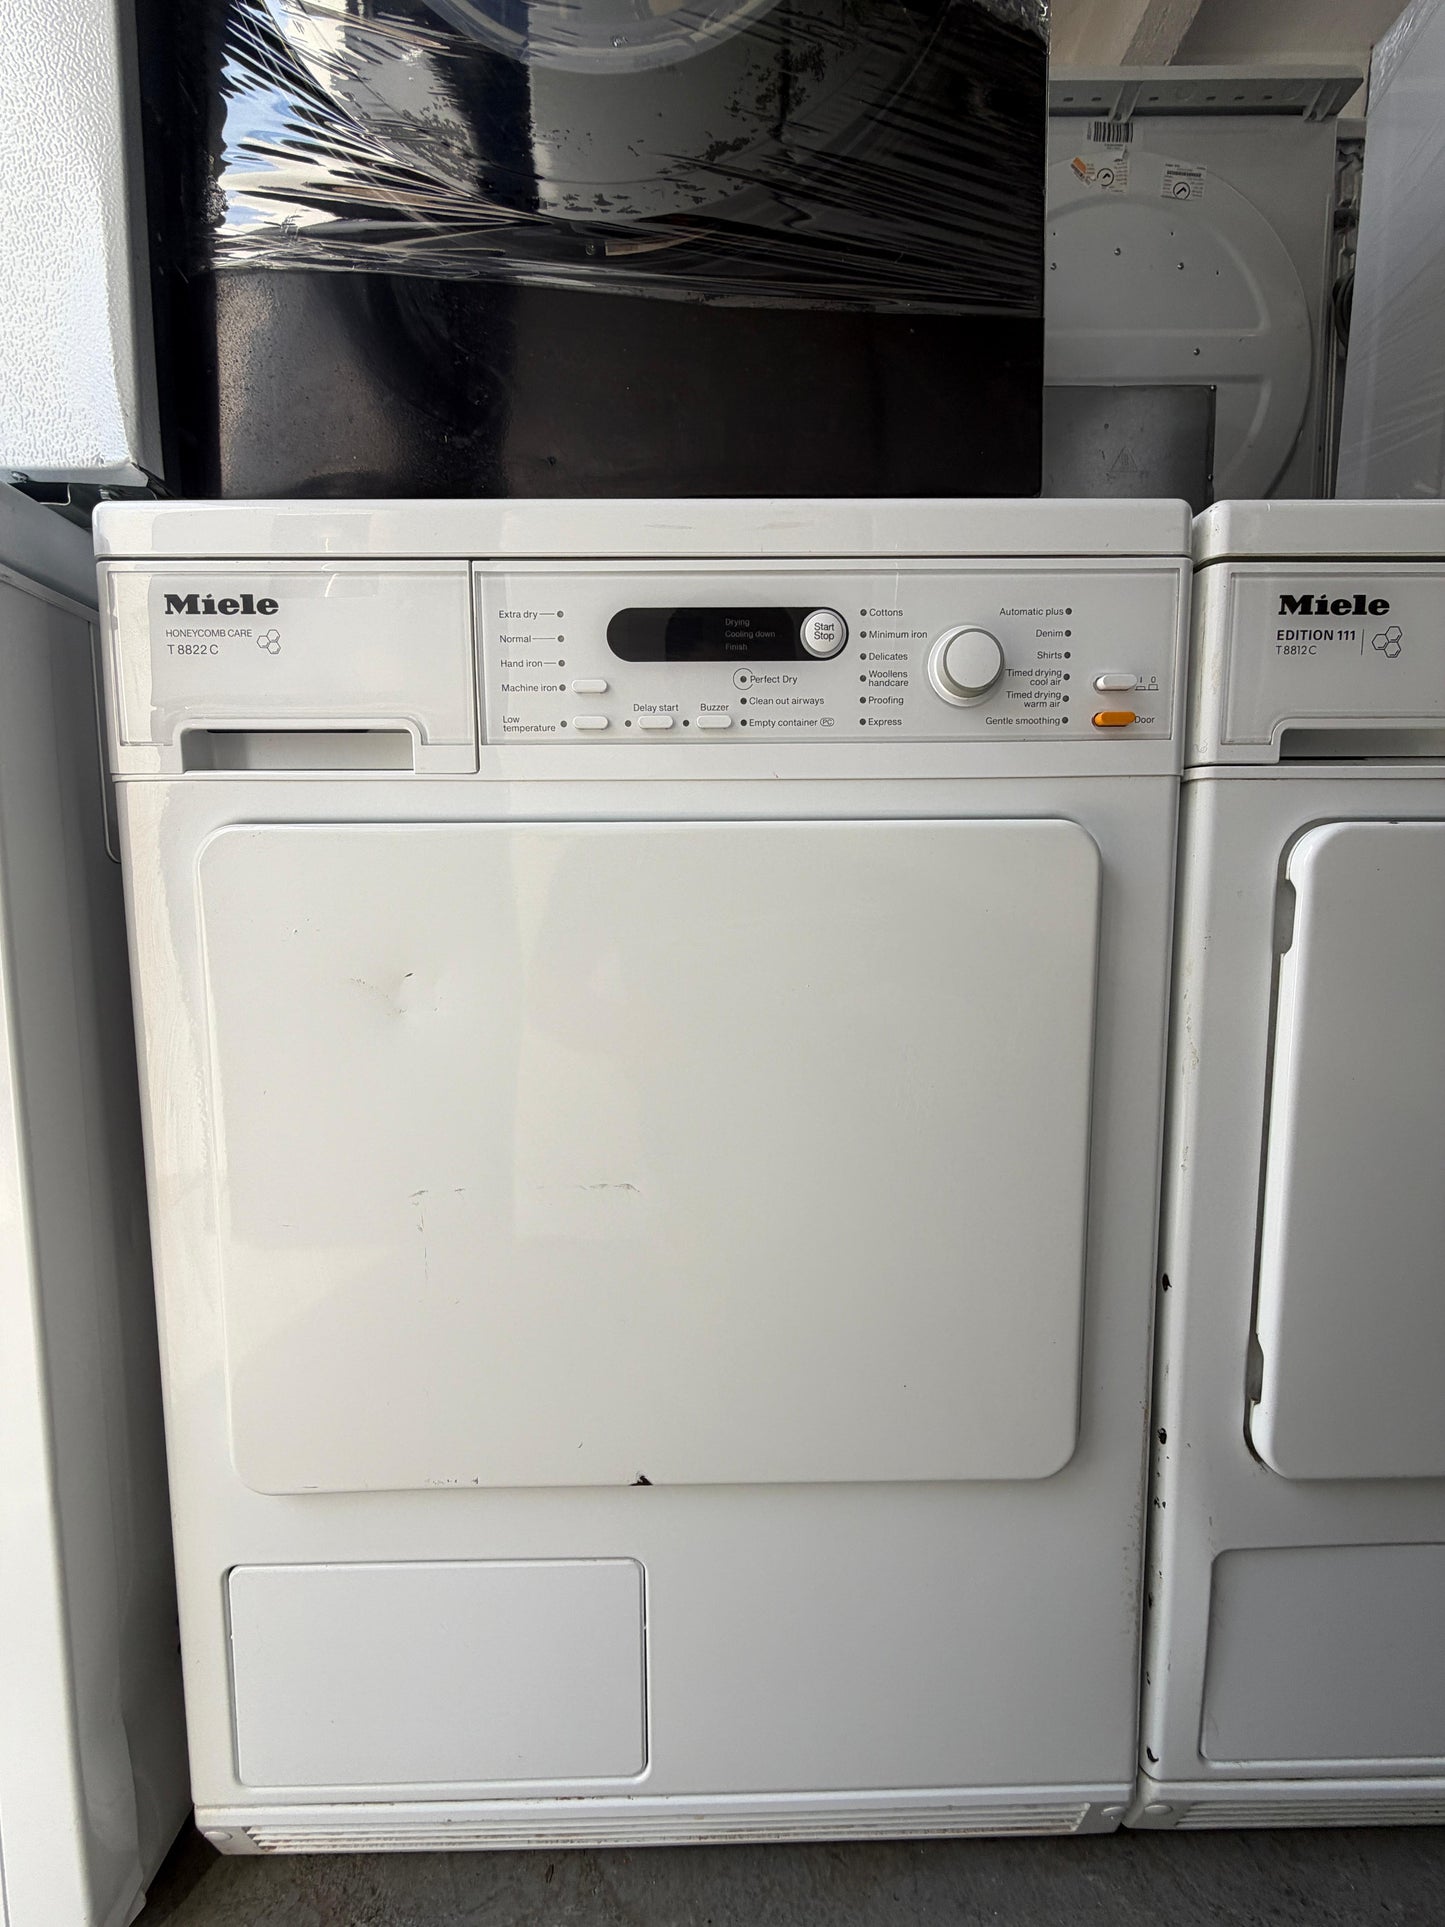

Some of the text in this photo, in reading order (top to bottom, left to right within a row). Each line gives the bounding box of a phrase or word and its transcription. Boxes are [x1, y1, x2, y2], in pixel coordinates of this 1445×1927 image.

[164, 593, 279, 615] Miele
[1278, 594, 1390, 616] Miele
[499, 610, 538, 620] Extra dry
[869, 608, 904, 617] Cottons
[1000, 607, 1064, 617] Automatic plus
[725, 618, 750, 627] Drying
[814, 622, 835, 631] Start
[165, 629, 253, 638] HONEYCOMB CARE
[725, 630, 776, 639] Cooling down
[814, 631, 835, 642] Stop
[869, 630, 928, 639] Minimum iron
[1035, 629, 1063, 638] Denim
[1276, 629, 1356, 641] EDITION 111
[500, 634, 532, 643] Normal
[167, 644, 175, 655] T
[177, 644, 207, 655] 8822
[725, 643, 748, 651] Finish
[868, 652, 908, 661] Delicates
[1037, 651, 1062, 659] Shirts
[500, 659, 543, 668] Hand iron
[868, 670, 908, 678] Woollens
[1006, 669, 1062, 678] Timed drying
[750, 675, 798, 685] Perfect Dry
[868, 678, 909, 687] handcare
[1029, 678, 1061, 686] cool air
[501, 683, 558, 692] Machine iron
[1006, 691, 1062, 700] Timed drying
[749, 697, 825, 706] Clean out airways
[868, 696, 904, 706] Proofing
[1049, 700, 1061, 708] air
[633, 703, 679, 713] Delay start
[700, 703, 729, 712] Buzzer
[502, 715, 520, 724] Low
[749, 719, 776, 728] Empty
[778, 719, 818, 727] container
[868, 718, 903, 727] Express
[985, 716, 1061, 726] Gentle smoothing
[1134, 715, 1155, 724] Door
[503, 724, 556, 733] temperature
